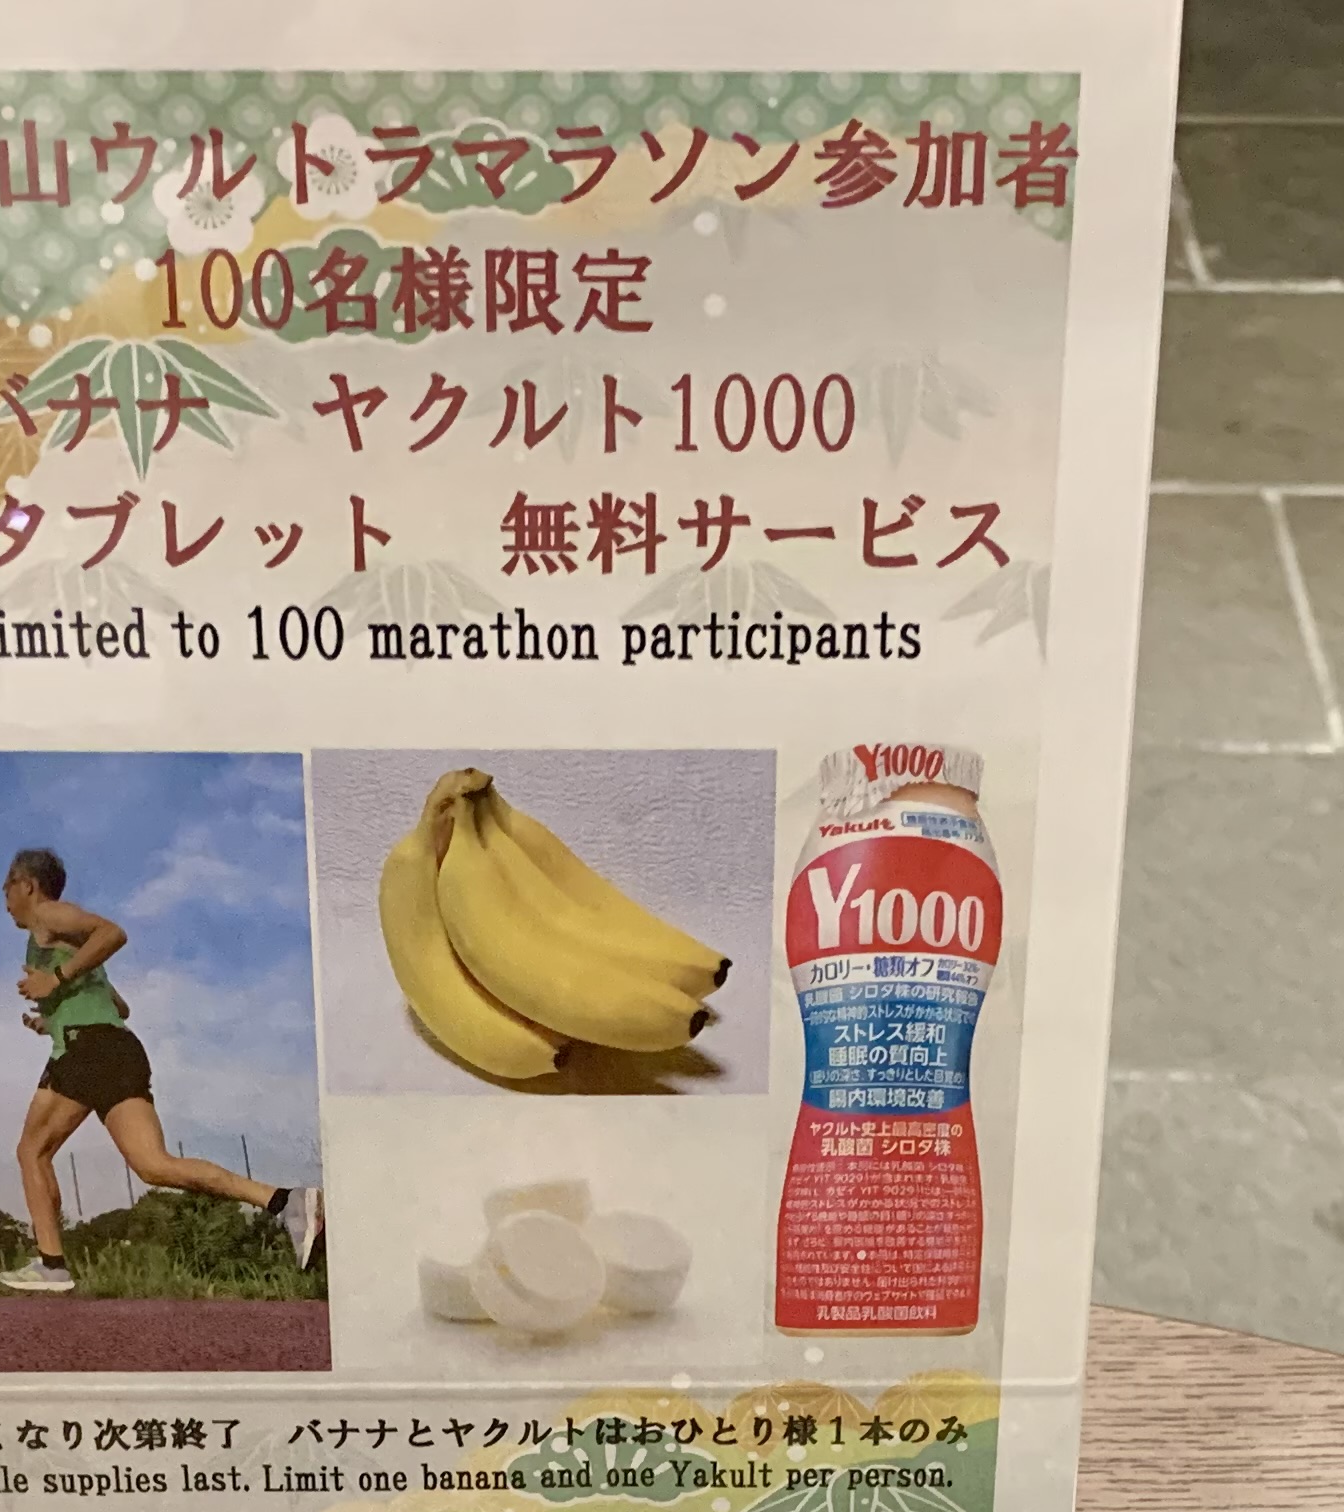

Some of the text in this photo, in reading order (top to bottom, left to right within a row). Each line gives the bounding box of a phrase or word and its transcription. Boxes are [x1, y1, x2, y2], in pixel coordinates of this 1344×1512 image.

[158, 246, 653, 334] 100名様限定
[313, 372, 854, 453] ヤクルト1000
[500, 490, 1010, 575] 無料サービス
[172, 611, 219, 659] to
[247, 605, 344, 660] 100
[369, 607, 599, 660] marathon
[622, 611, 921, 665] participants
[853, 743, 944, 782] Y1000
[818, 817, 895, 838] Yakult
[808, 863, 985, 952] Y1000
[829, 1046, 948, 1067] 睡眠の質向上
[834, 1022, 946, 1045] ストレス緩和
[43, 1465, 168, 1496] supplies
[181, 1464, 251, 1493] last.
[263, 1465, 344, 1493] Limit
[359, 1471, 408, 1492] one
[422, 1463, 527, 1491] banana
[540, 1461, 593, 1488] and
[606, 1467, 655, 1488] one
[668, 1460, 774, 1489] Yakult
[786, 1467, 834, 1492] per
[847, 1467, 953, 1492] person.
